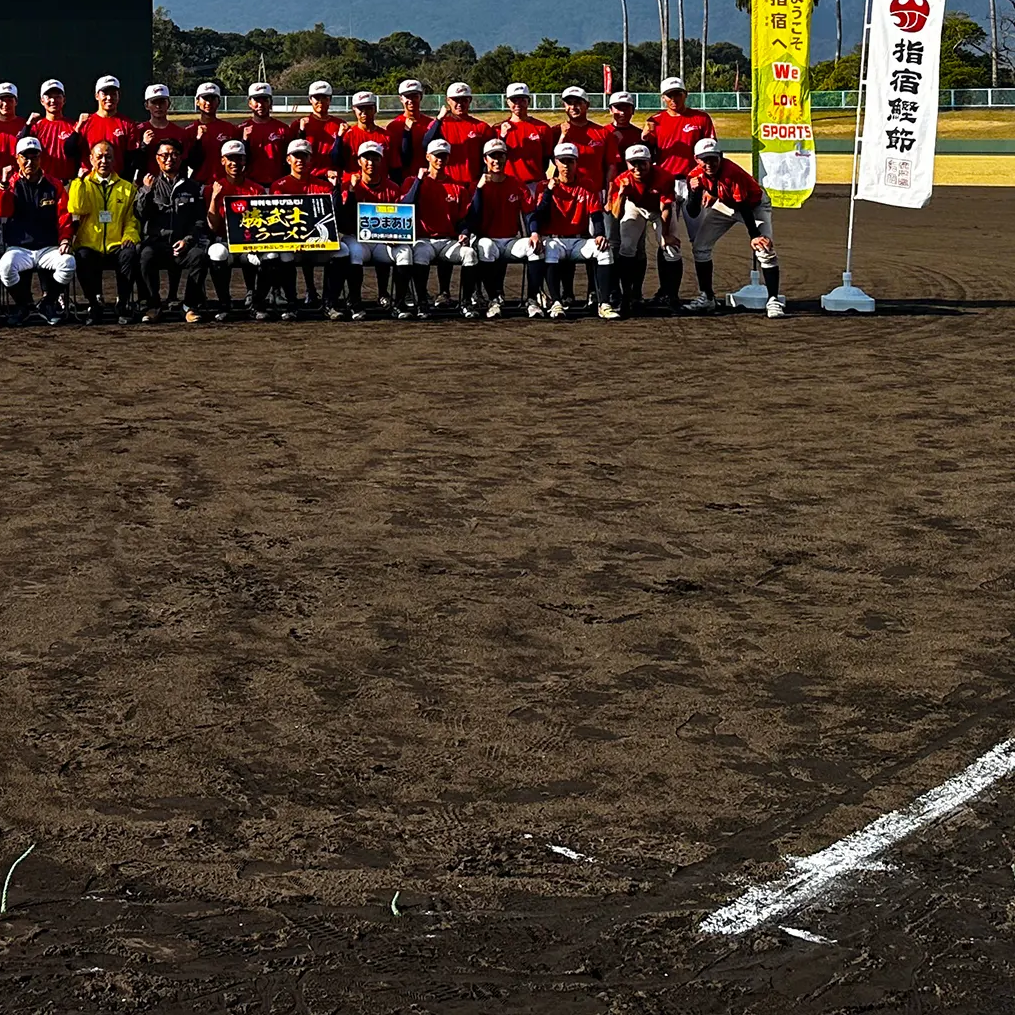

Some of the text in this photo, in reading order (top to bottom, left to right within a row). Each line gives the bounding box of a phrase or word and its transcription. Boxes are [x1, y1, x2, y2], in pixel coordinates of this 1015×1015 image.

[773, 63, 799, 79] We
[773, 94, 797, 106] LOVE
[885, 38, 925, 153] 指宿鰹節
[762, 124, 811, 139] SPORTS
[255, 226, 315, 241] ラーメン
